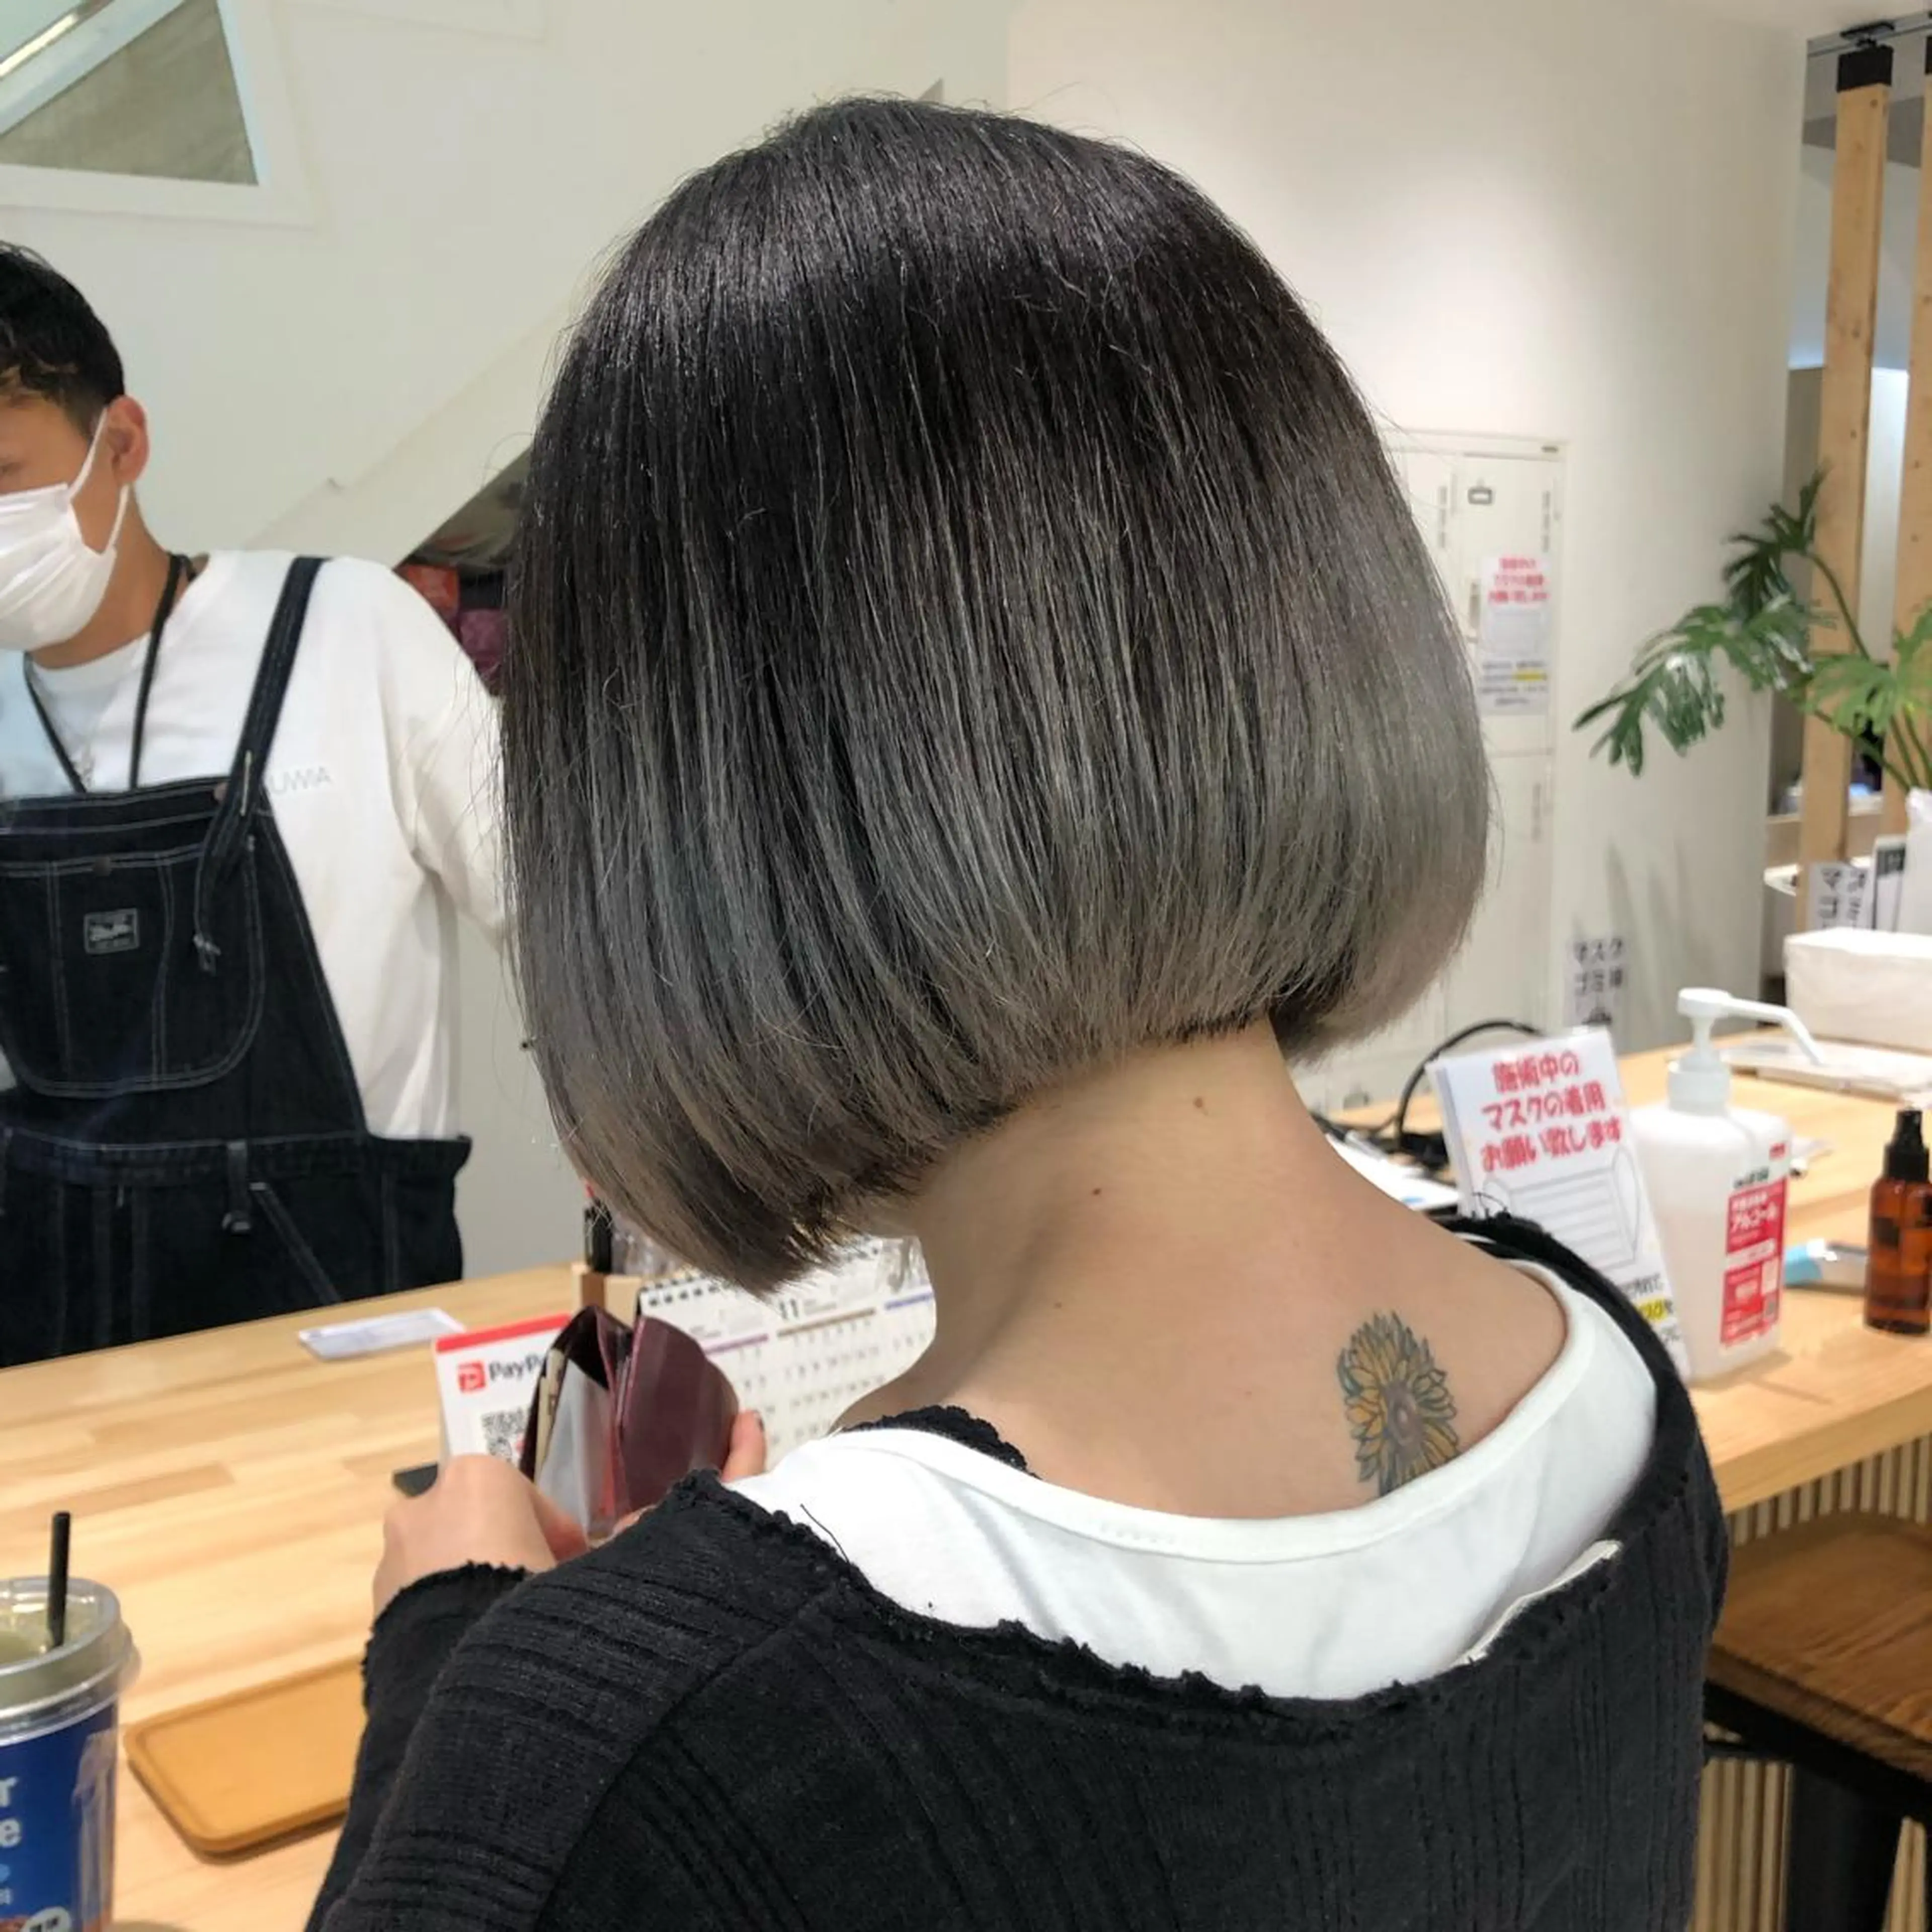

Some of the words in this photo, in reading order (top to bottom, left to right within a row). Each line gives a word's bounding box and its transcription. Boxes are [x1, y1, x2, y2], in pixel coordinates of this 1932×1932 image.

[1492, 1050, 1580, 1094] 施術中の
[1481, 1080, 1606, 1131] マスクの着用
[1480, 1115, 1622, 1173] お願い致します
